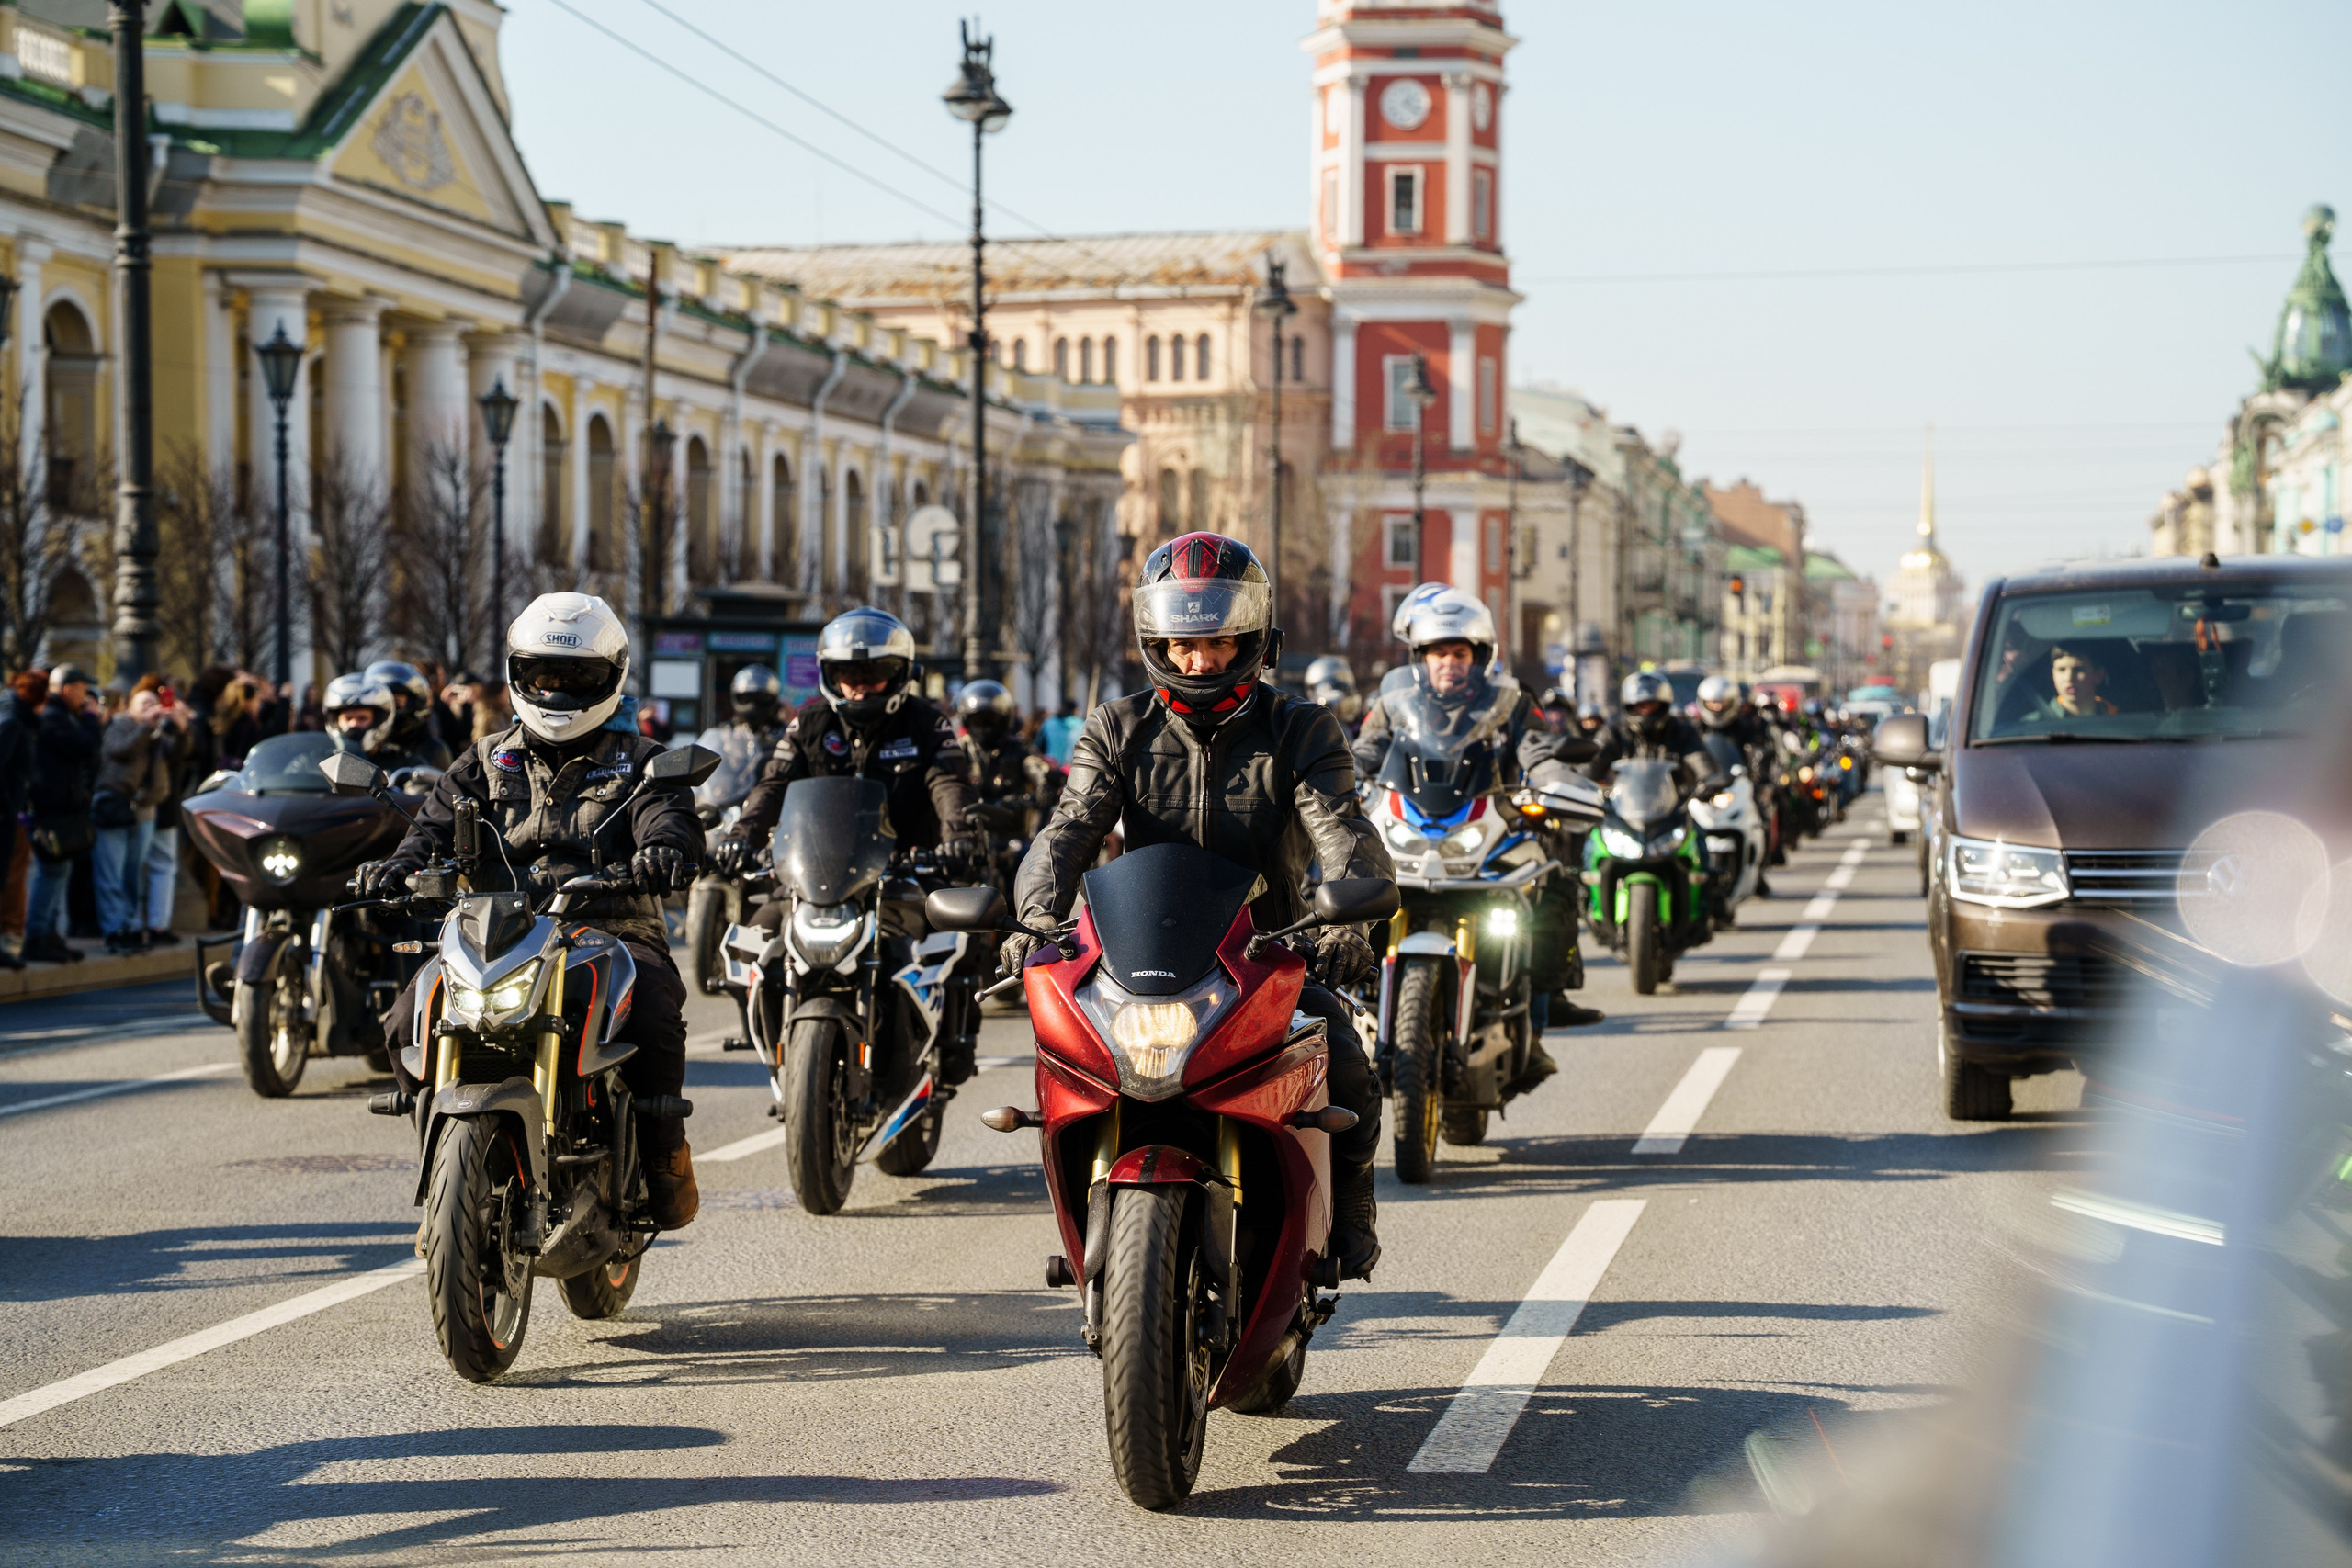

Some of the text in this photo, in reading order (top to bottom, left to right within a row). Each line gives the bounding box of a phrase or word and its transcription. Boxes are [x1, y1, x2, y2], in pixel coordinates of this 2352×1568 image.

[1170, 613, 1220, 623] SHARK
[546, 634, 577, 646] SHOEI
[1130, 970, 1176, 978] HONDA
